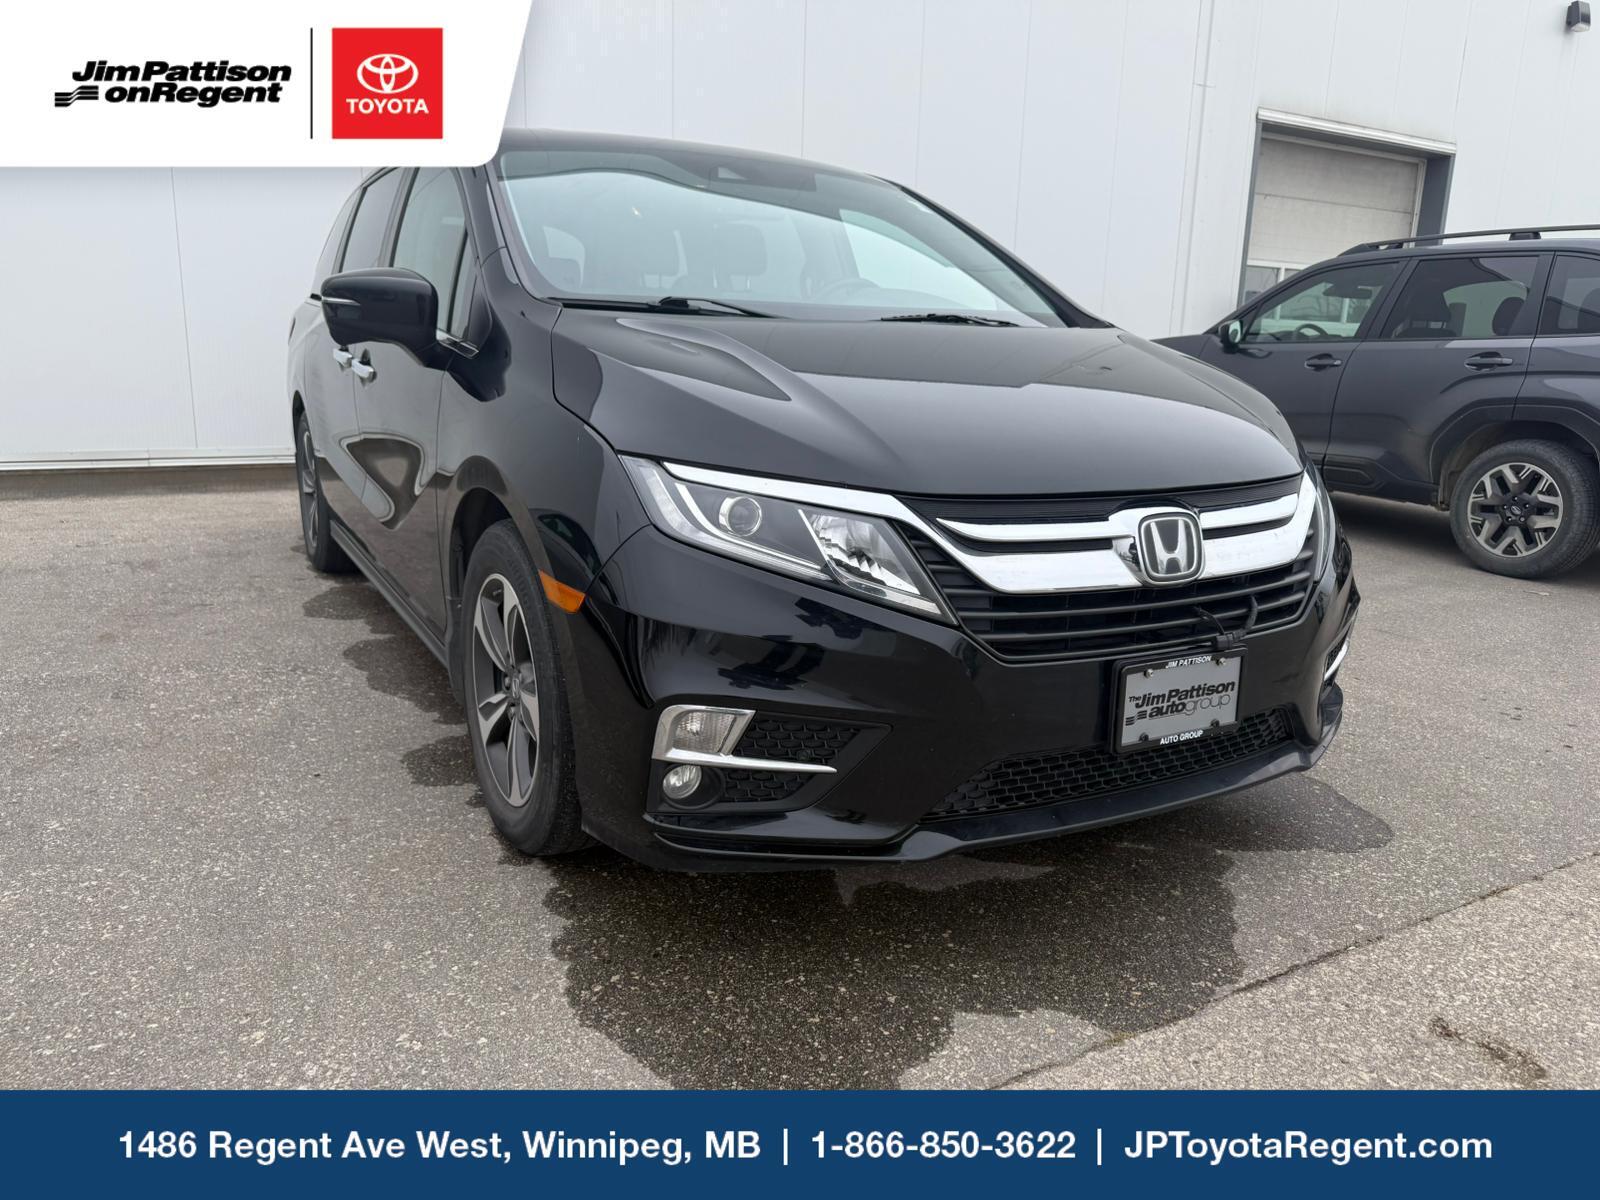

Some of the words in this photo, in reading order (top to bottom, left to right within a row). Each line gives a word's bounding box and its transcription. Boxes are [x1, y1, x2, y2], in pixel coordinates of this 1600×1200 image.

[1165, 660, 1178, 669] JIM
[1179, 655, 1212, 668] PATTISON
[1160, 736, 1178, 745] AUTO
[1179, 730, 1204, 741] GROUP
